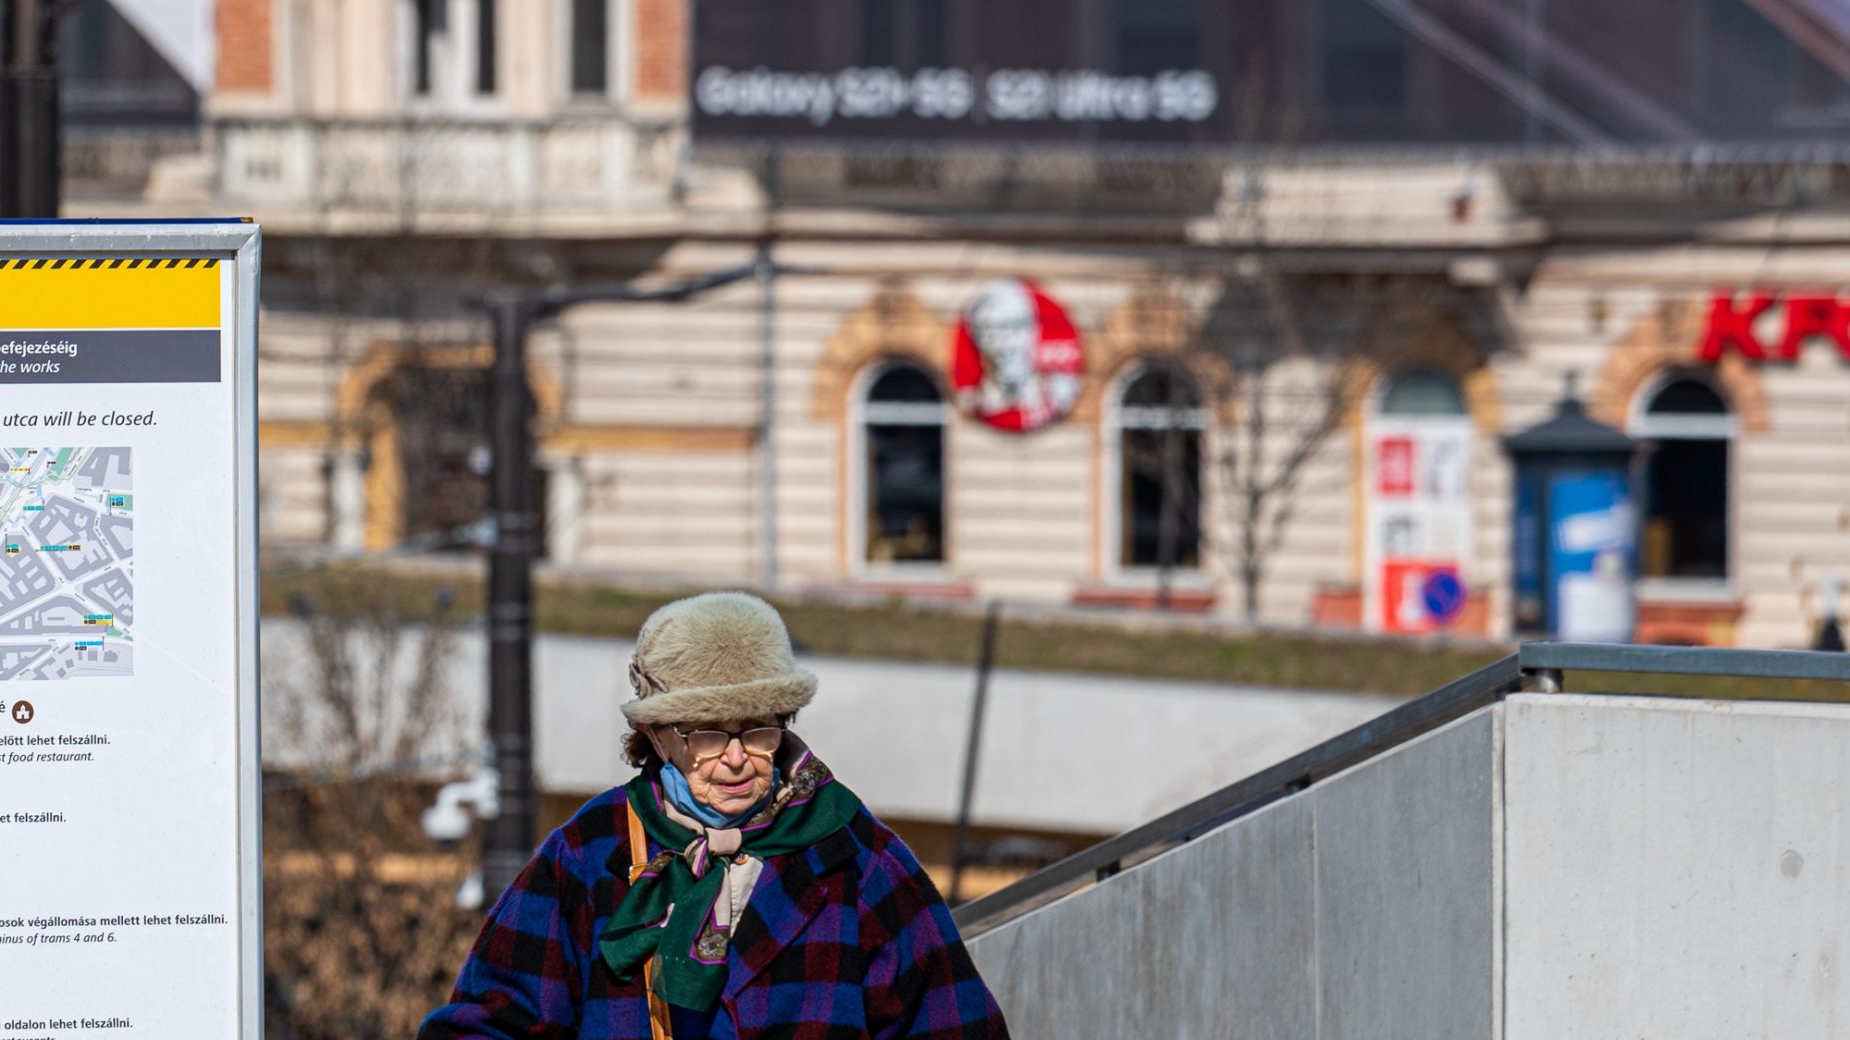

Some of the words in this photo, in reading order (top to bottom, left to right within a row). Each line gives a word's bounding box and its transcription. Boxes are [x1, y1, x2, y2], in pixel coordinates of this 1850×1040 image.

[20, 360, 60, 373] works
[3, 413, 38, 427] utca
[44, 411, 72, 426] will
[77, 411, 97, 426] be
[102, 410, 157, 426] closed.
[27, 735, 55, 745] lehet
[58, 734, 110, 745] felszállni.
[14, 812, 66, 823] felszállni.
